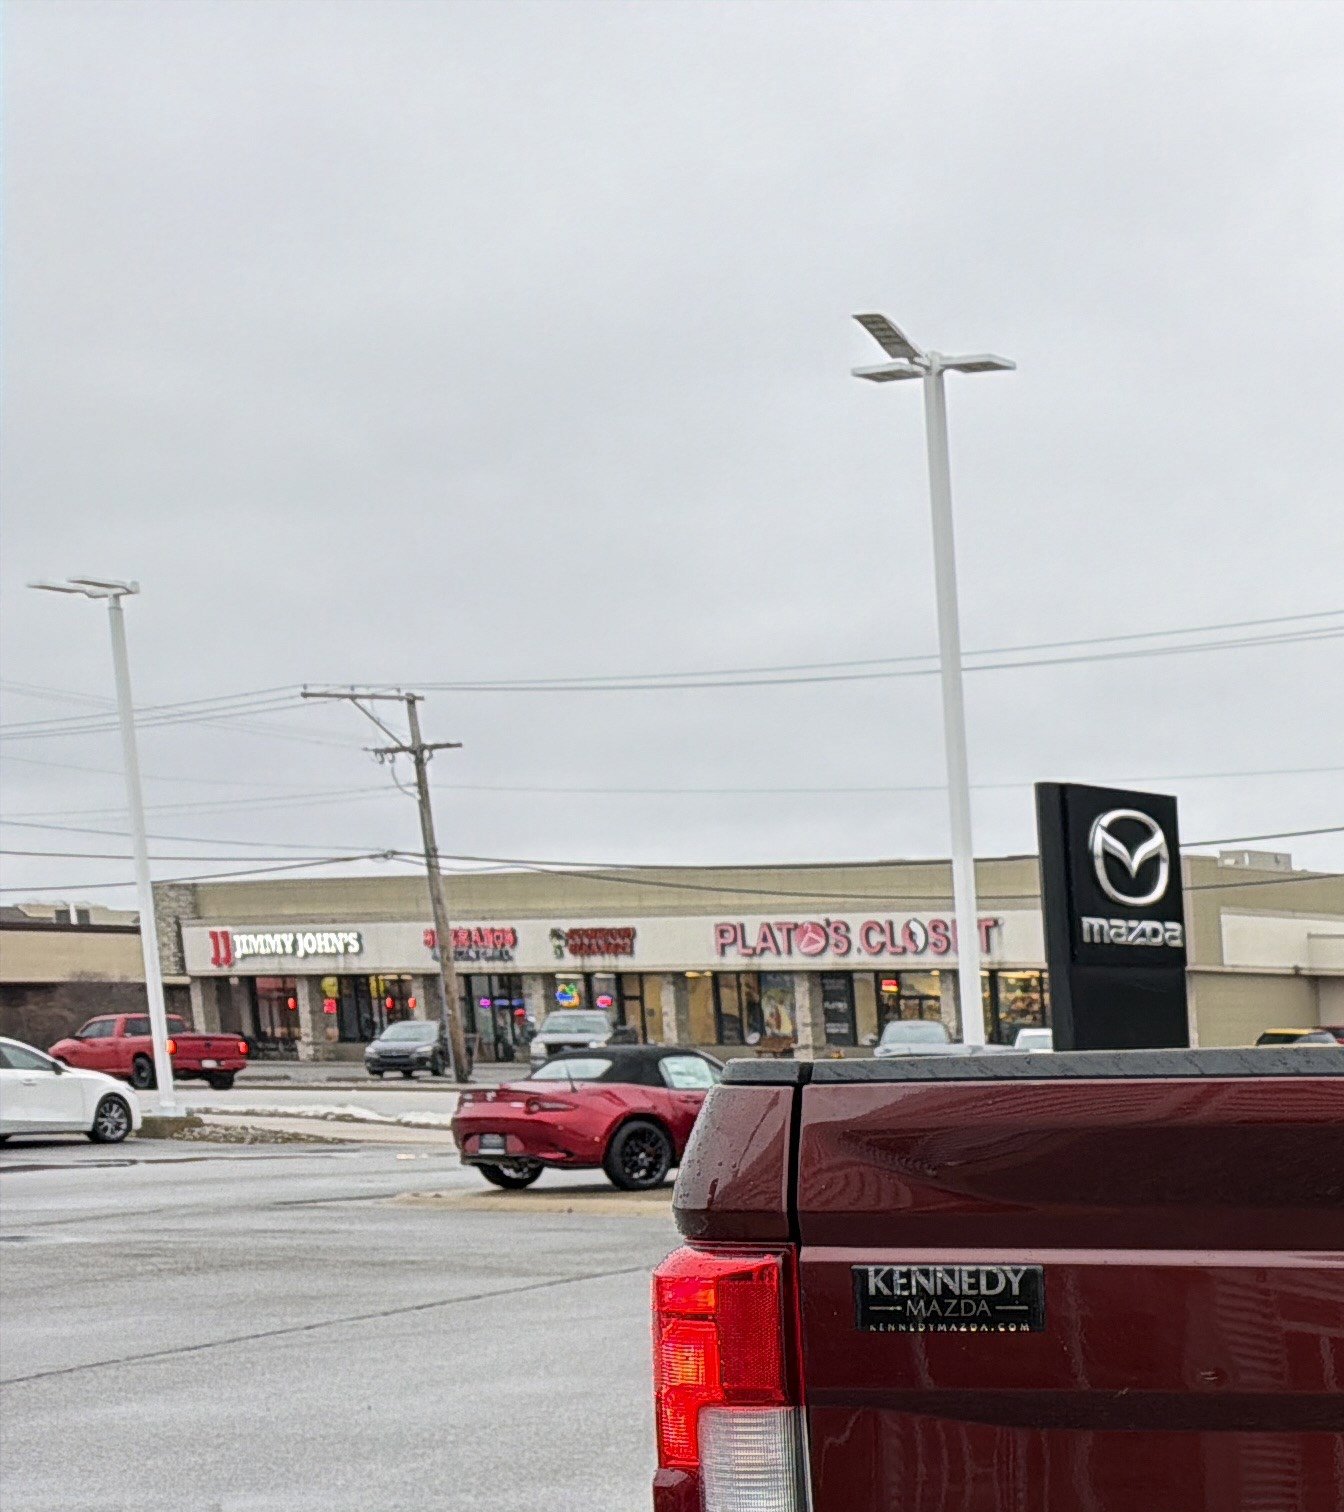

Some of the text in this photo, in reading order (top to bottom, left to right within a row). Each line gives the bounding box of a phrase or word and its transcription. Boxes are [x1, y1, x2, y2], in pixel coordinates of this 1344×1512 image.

[233, 932, 361, 959] JIMMY JOHN'S
[714, 917, 1000, 956] PLATO'S CLOST
[867, 1266, 1026, 1296] KENNEDY
[905, 1299, 992, 1317] MAZDA
[869, 1322, 1030, 1332] KENNEDYMAZDA.COM
